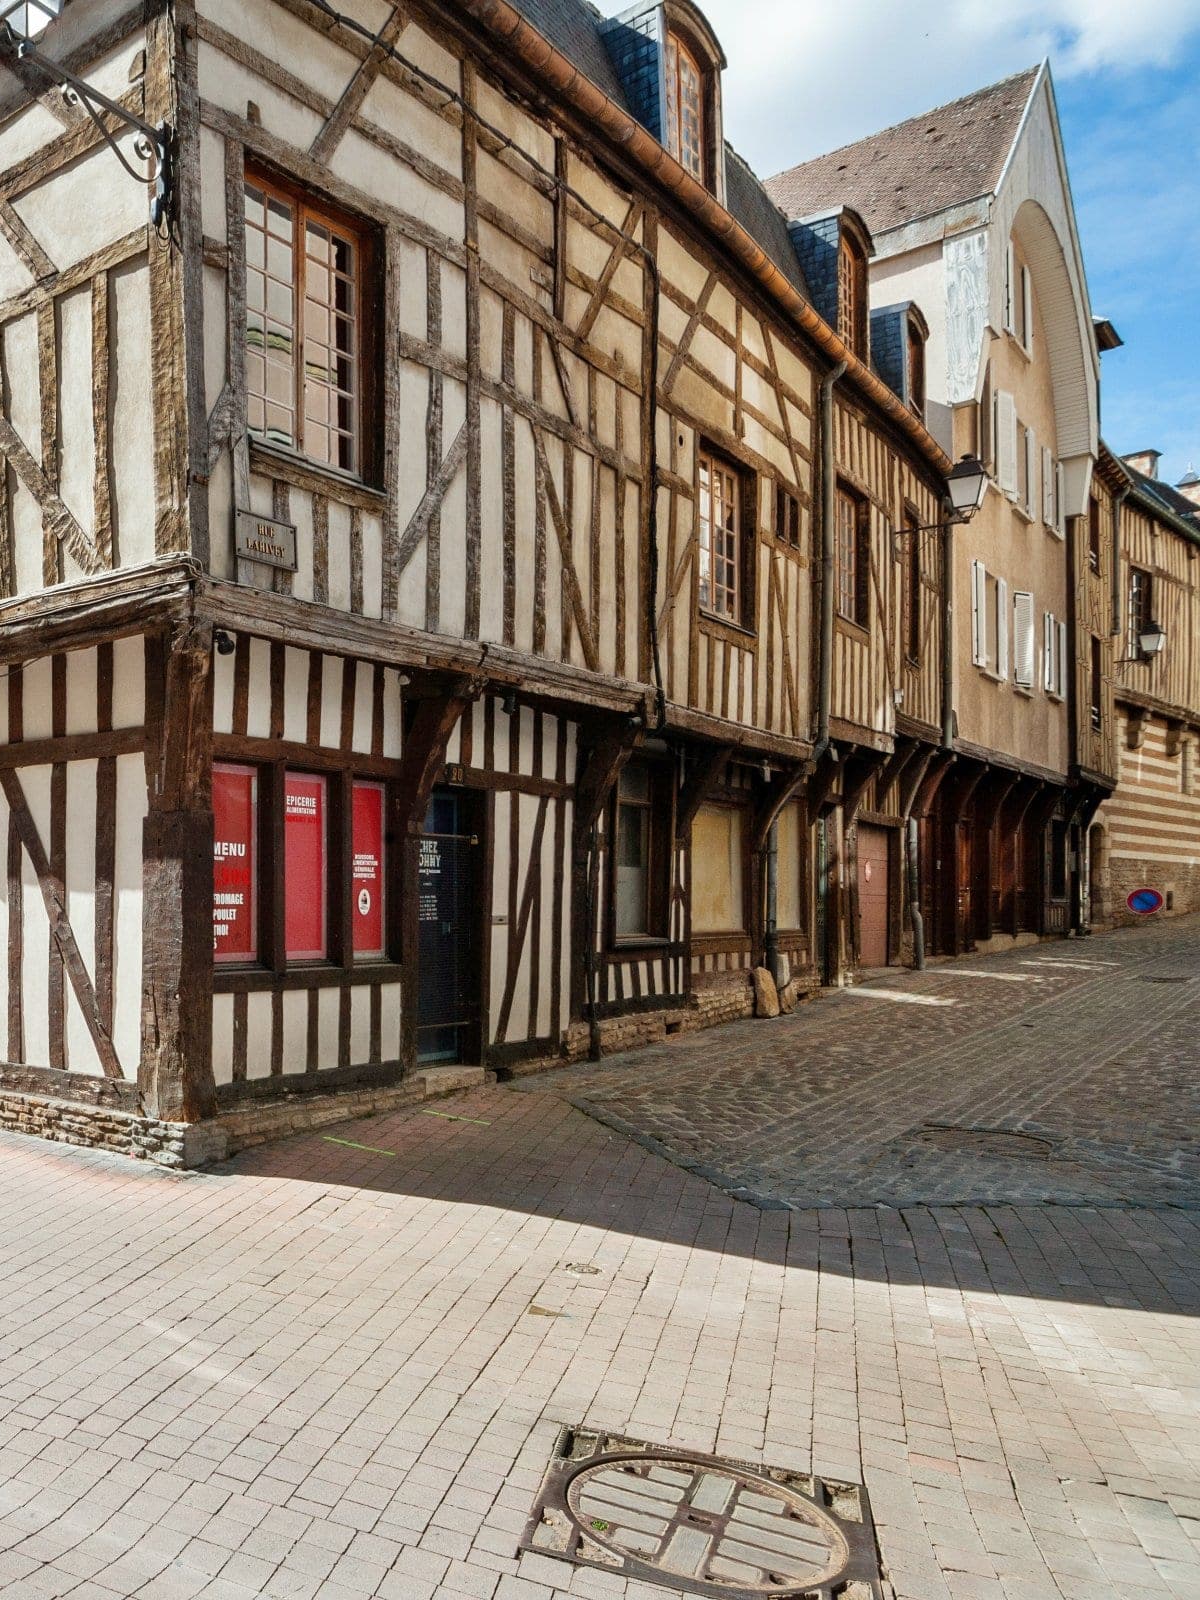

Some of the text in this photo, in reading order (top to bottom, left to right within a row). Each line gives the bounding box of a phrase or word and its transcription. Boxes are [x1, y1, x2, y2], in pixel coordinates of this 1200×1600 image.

[257, 524, 276, 538] RUE
[246, 538, 285, 558] LARIVEY
[286, 795, 316, 808] EPICERIE
[286, 806, 316, 815] ALIMENTATION
[212, 908, 237, 920] POULET
